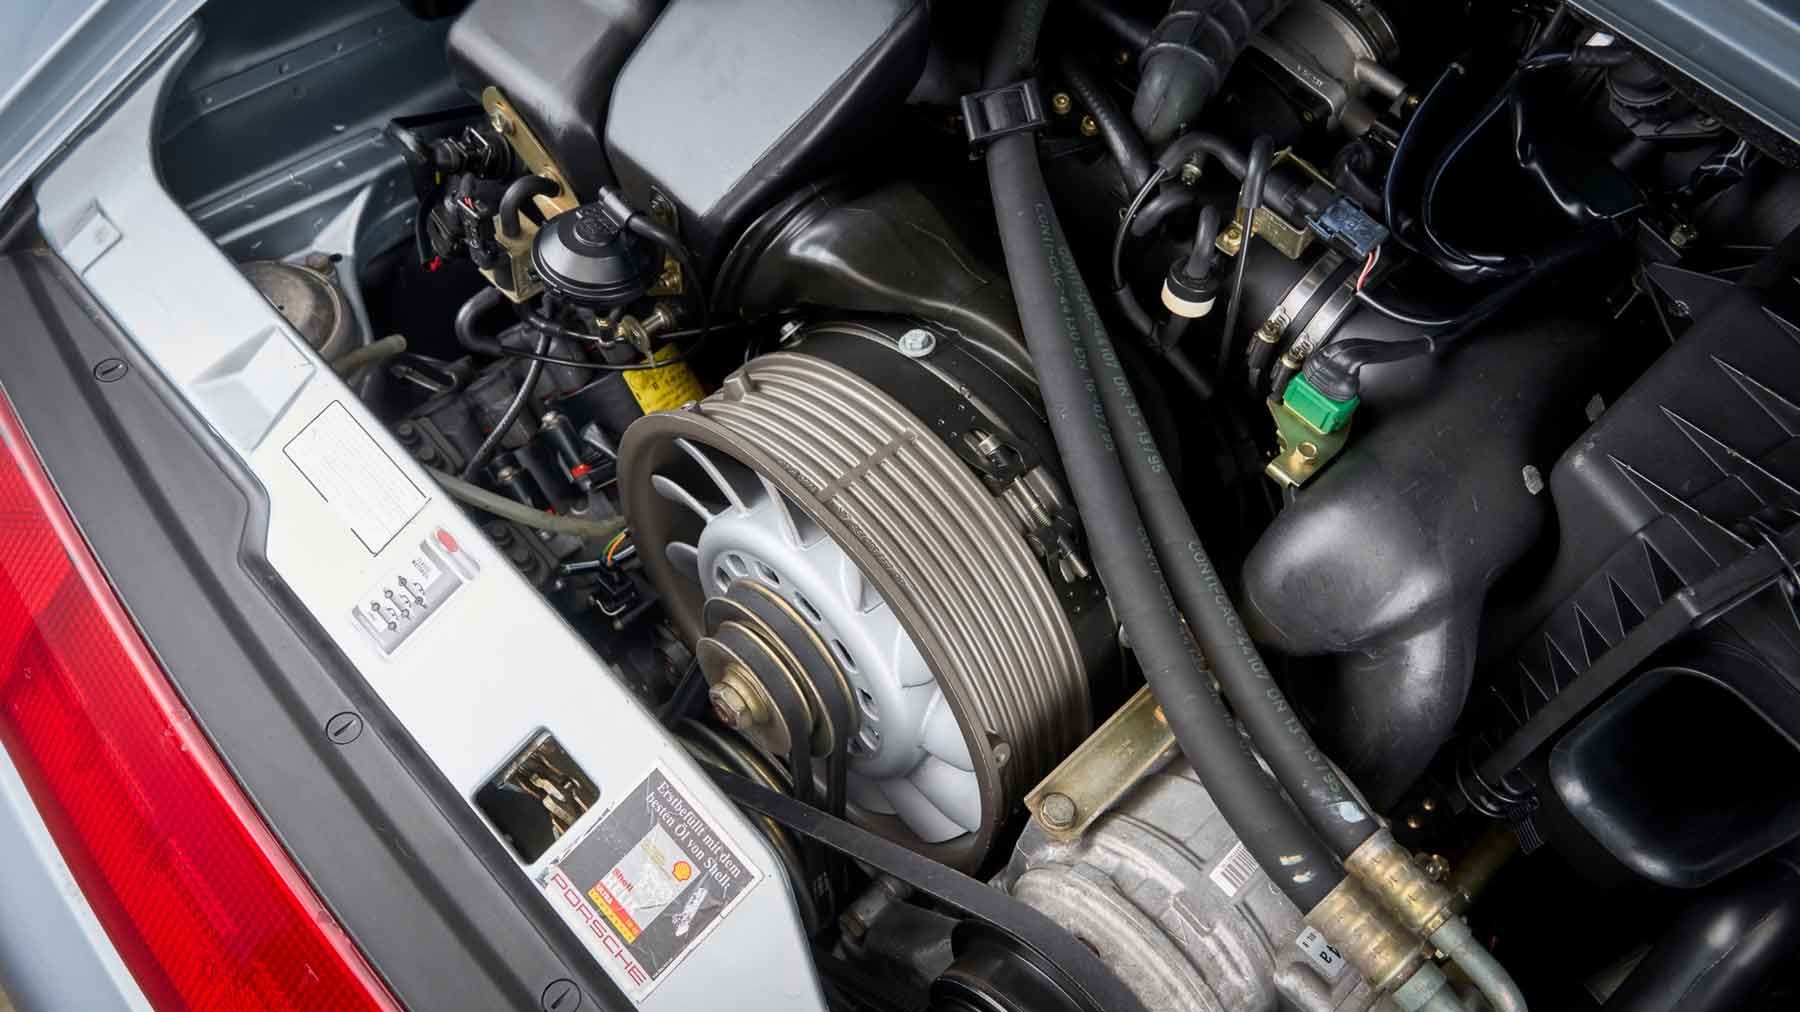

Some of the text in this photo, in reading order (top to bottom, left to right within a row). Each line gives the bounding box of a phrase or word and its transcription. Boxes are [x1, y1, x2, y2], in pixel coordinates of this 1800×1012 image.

[646, 791, 676, 827] besten
[674, 822, 691, 841] Öl
[687, 839, 706, 860] von
[703, 834, 722, 856] mit
[719, 852, 742, 879] dem
[550, 872, 647, 987] PORSCHE
